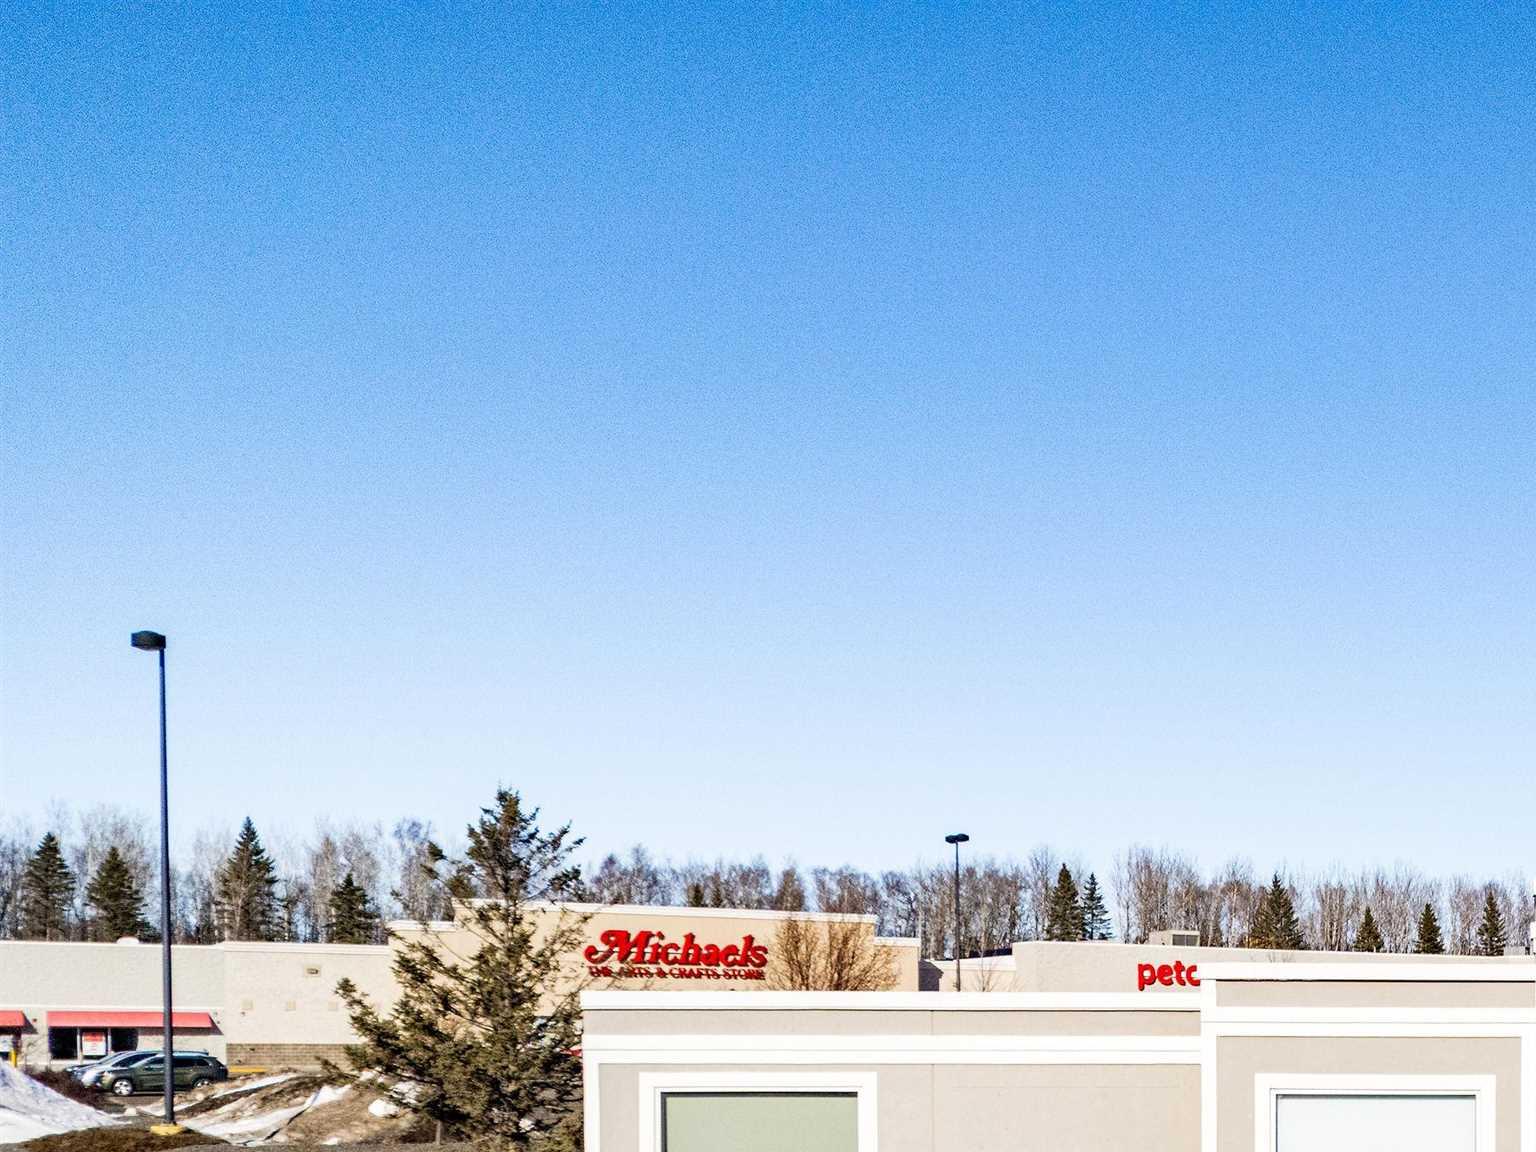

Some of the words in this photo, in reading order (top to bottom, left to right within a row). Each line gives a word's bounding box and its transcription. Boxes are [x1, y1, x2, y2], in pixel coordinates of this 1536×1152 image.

[584, 930, 768, 968] Michaels
[669, 967, 721, 980] CRAFTS
[722, 968, 766, 981] STORE
